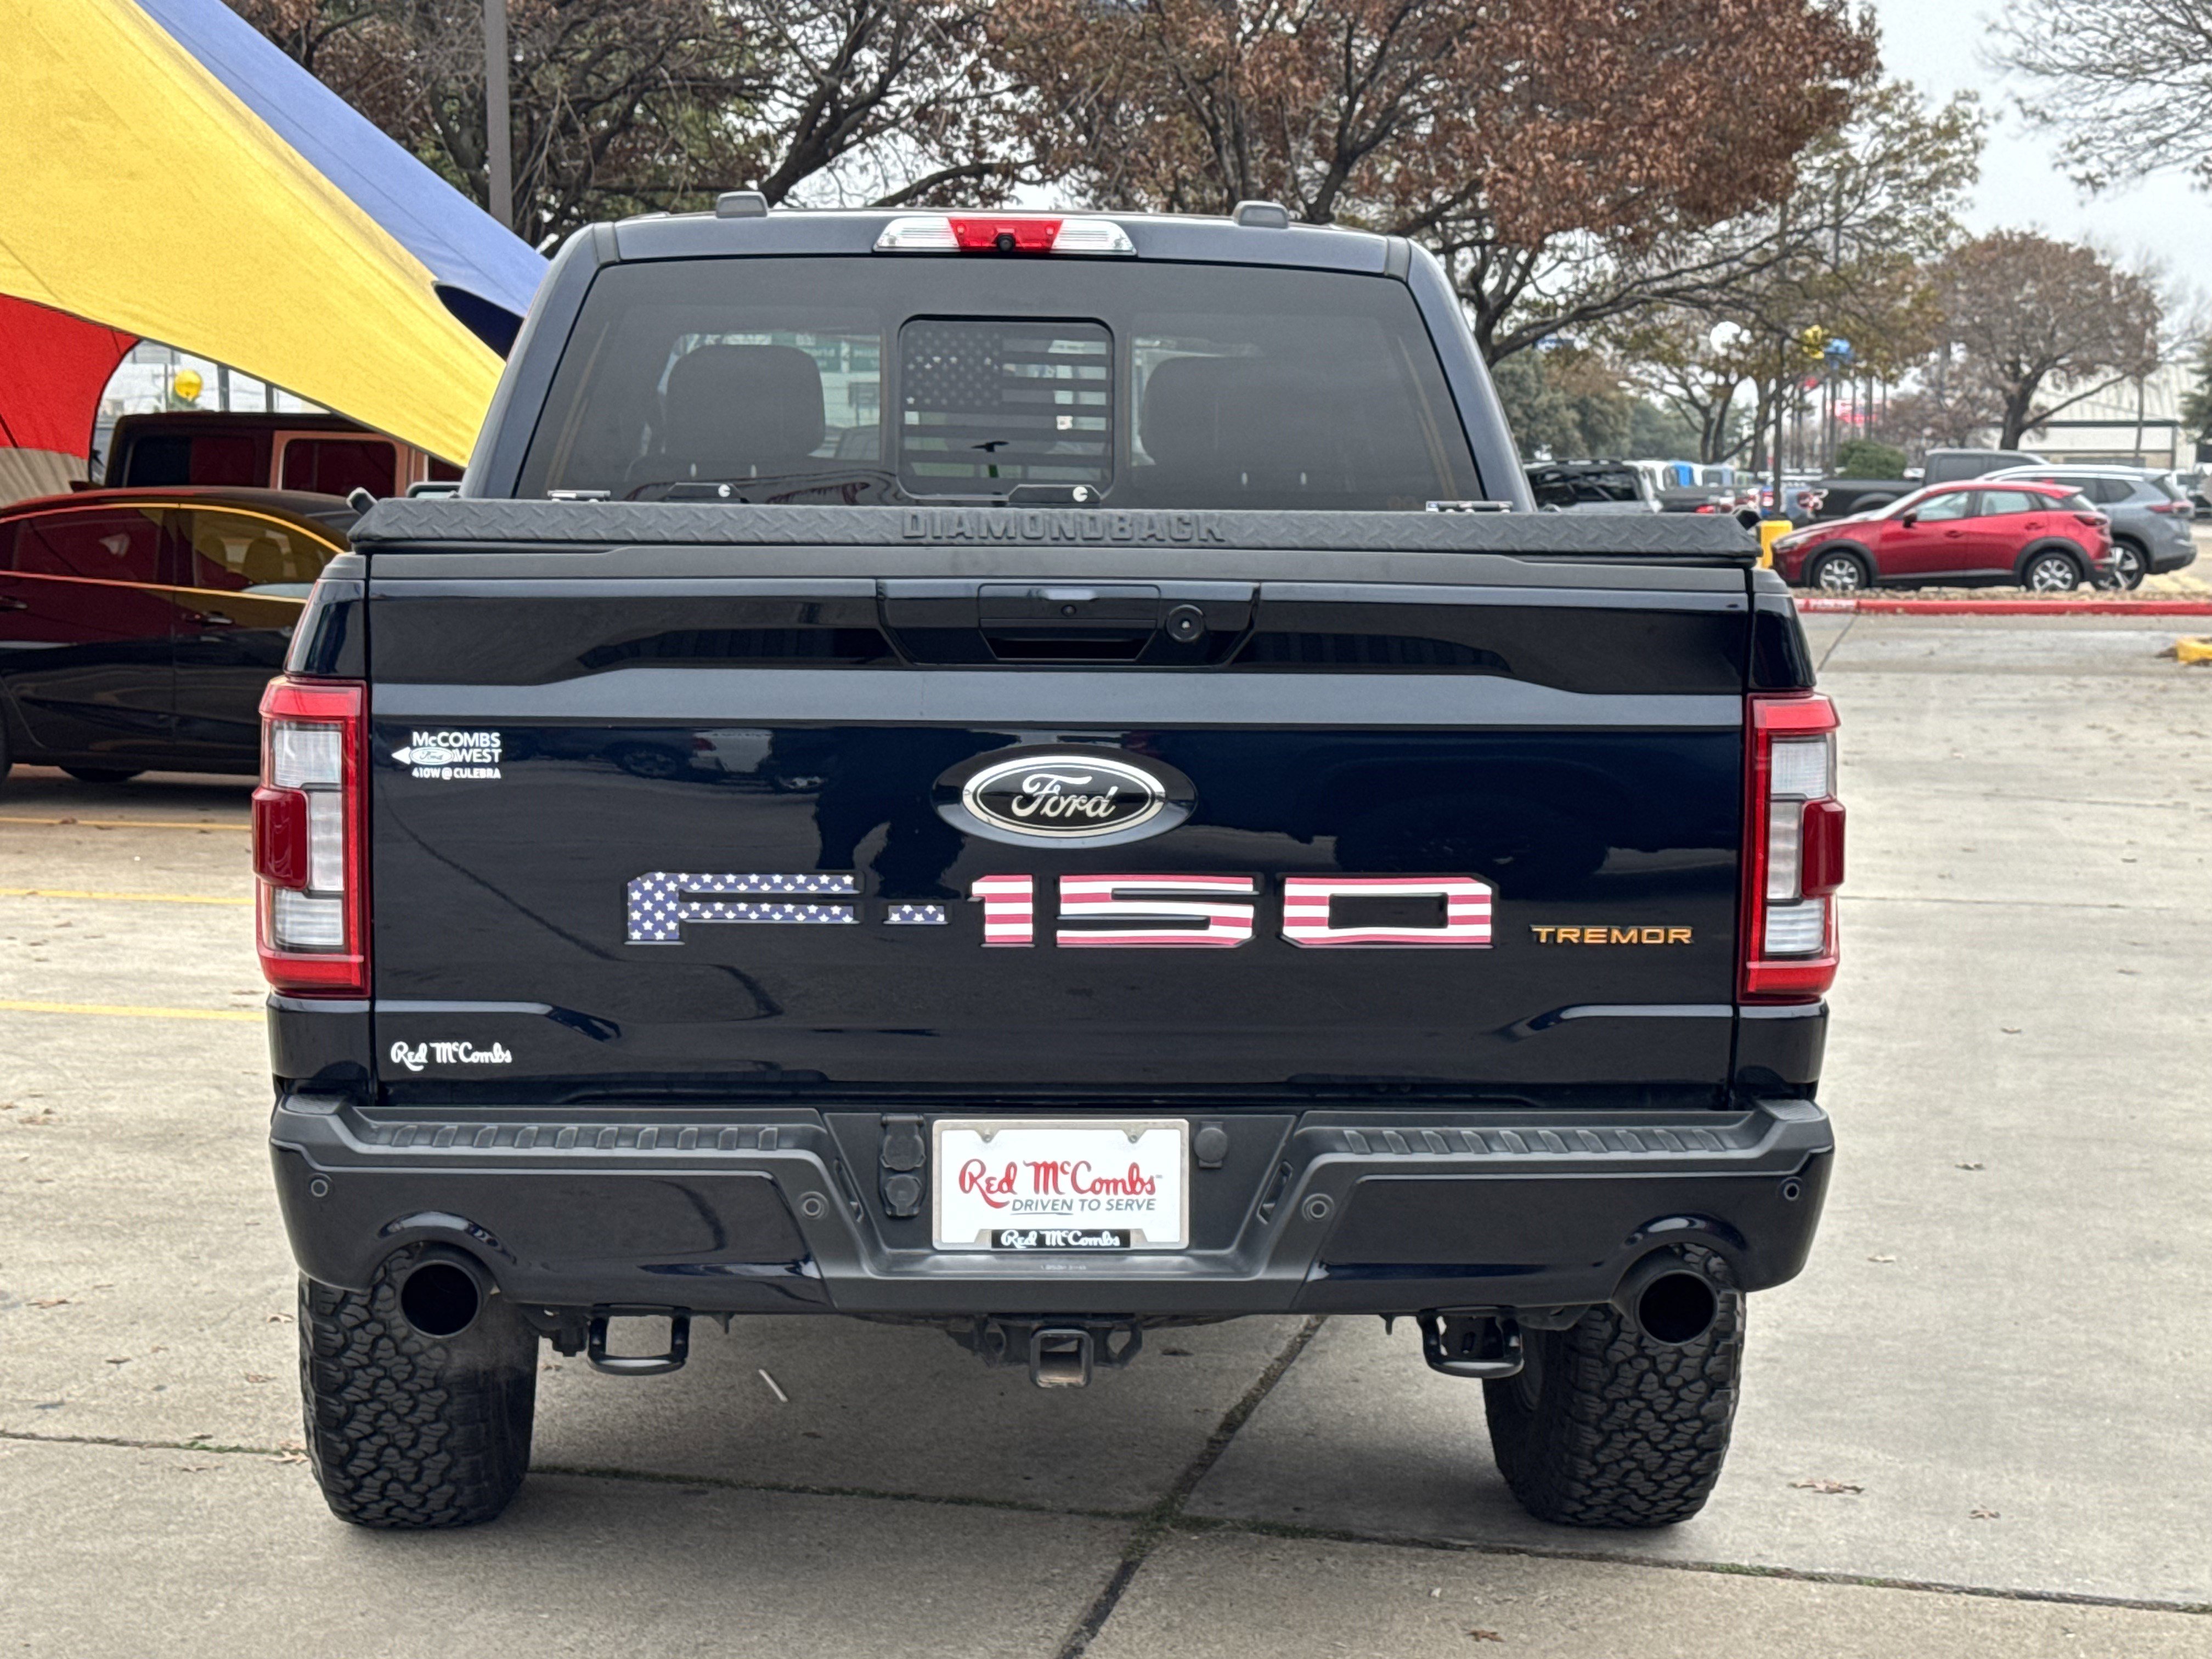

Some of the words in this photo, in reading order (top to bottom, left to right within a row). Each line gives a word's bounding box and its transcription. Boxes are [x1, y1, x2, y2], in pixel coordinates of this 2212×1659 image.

[902, 510, 1227, 542] DIAMONDBACK
[412, 731, 501, 748] McCOMBS
[453, 748, 502, 763] WEST
[1011, 773, 1119, 817] Ford
[625, 871, 1494, 951] F-150
[1528, 924, 1694, 944] TREMOR
[390, 1041, 428, 1071] Red
[429, 1041, 512, 1064] McCombs
[958, 1158, 1018, 1209] Red
[1022, 1160, 1156, 1195] McCombs
[1011, 1198, 1074, 1211] DRIVEN
[1079, 1198, 1102, 1211] TO
[1105, 1198, 1157, 1211] SERVE
[1001, 1229, 1037, 1249] Red
[1040, 1230, 1121, 1246] McCombs
